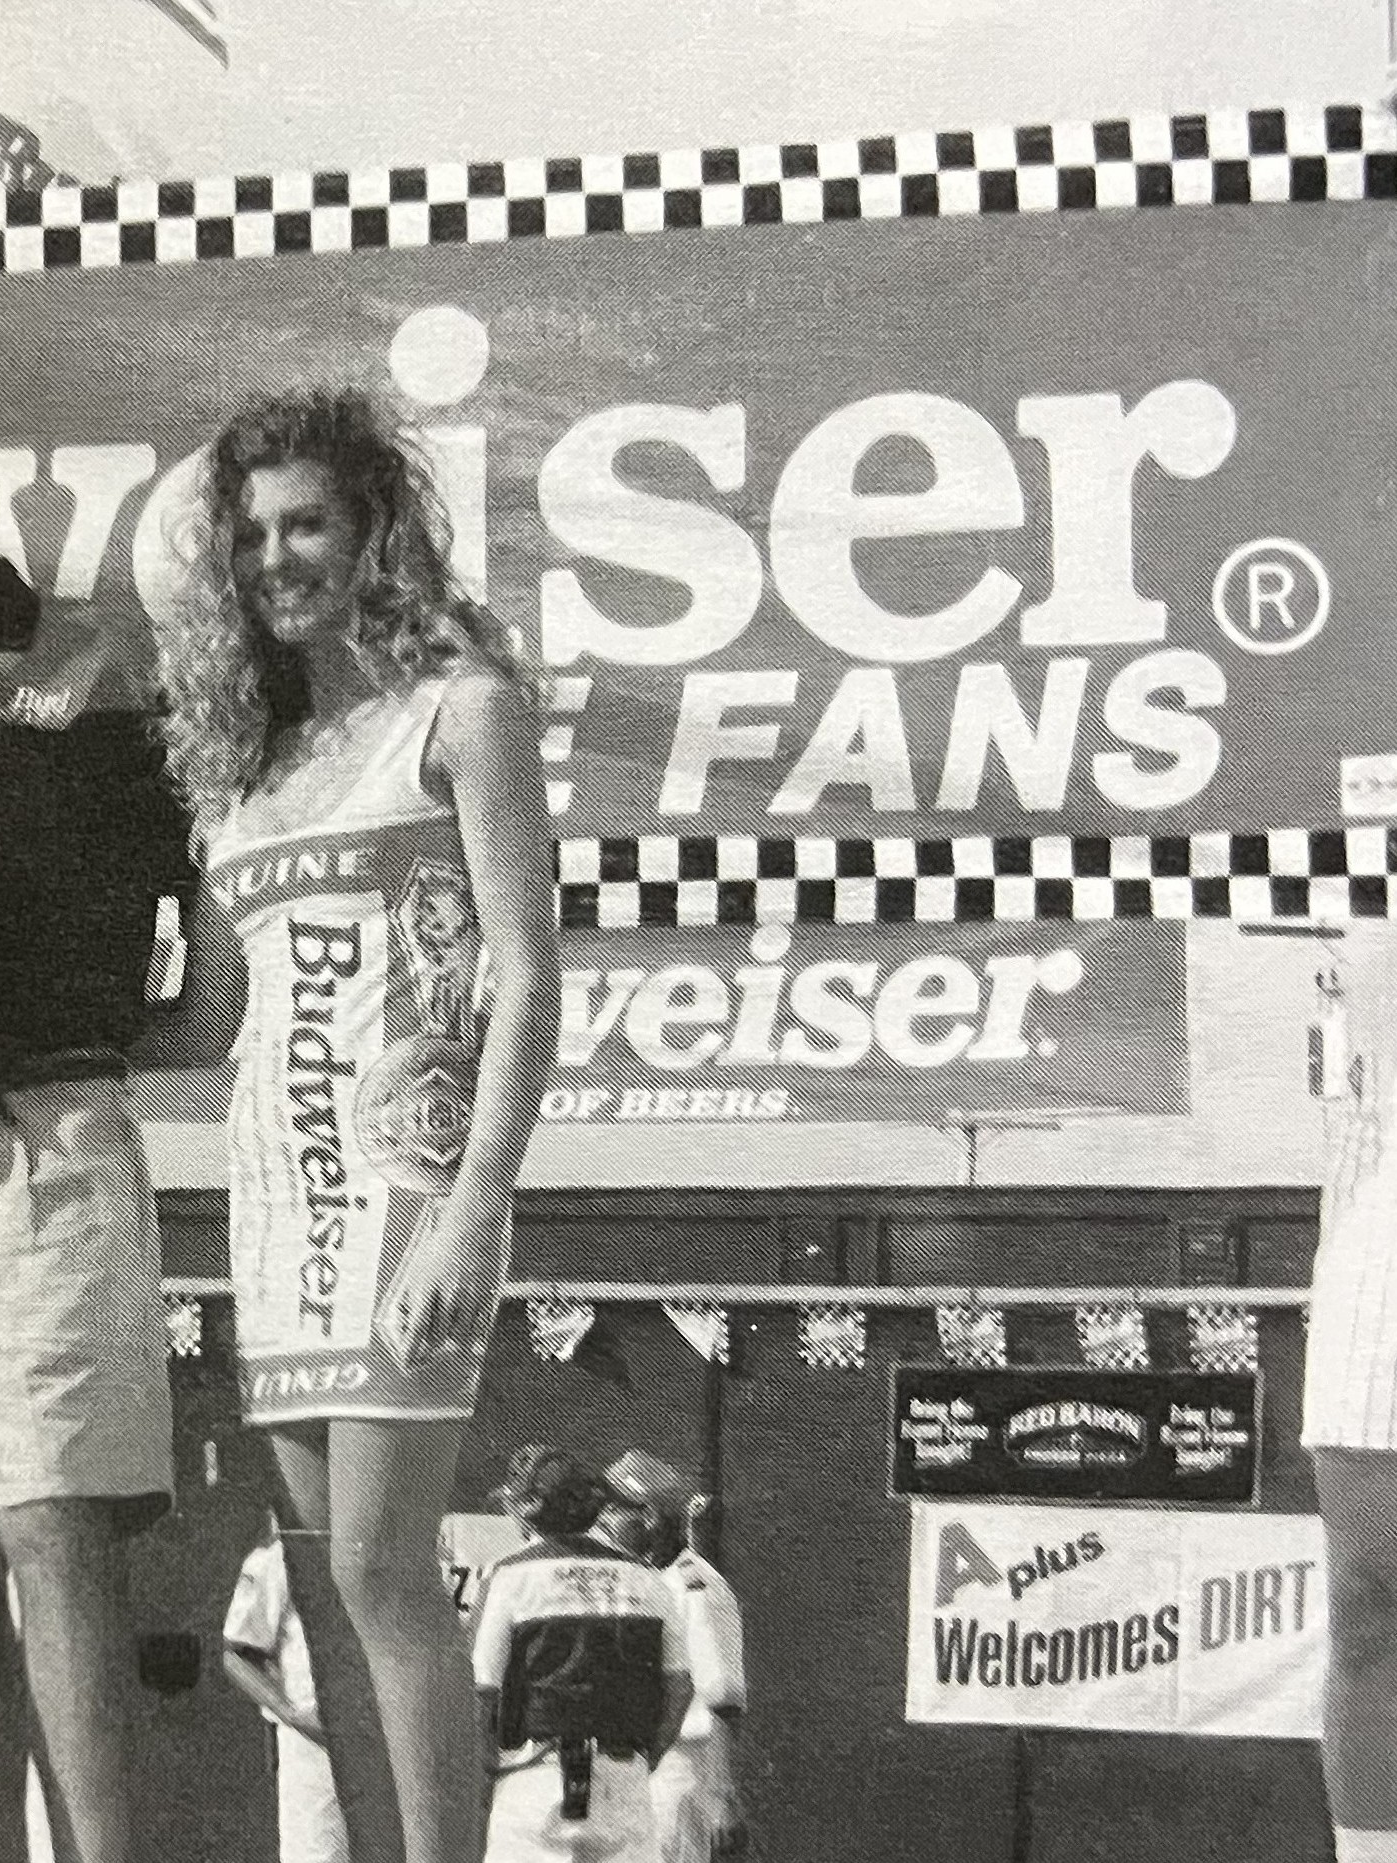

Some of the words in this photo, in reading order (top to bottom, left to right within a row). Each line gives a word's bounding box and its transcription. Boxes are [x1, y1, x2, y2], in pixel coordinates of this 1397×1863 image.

[657, 648, 1228, 816] FANS
[288, 919, 369, 1338] Budweiser
[539, 1085, 610, 1120] OF
[1008, 1405, 1056, 1439] RED
[1058, 1400, 1141, 1441] BARON
[934, 1520, 1004, 1610] A
[1006, 1530, 1106, 1601] plus
[933, 1603, 1181, 1688] Welcomes
[1199, 1560, 1317, 1652] DIRT
